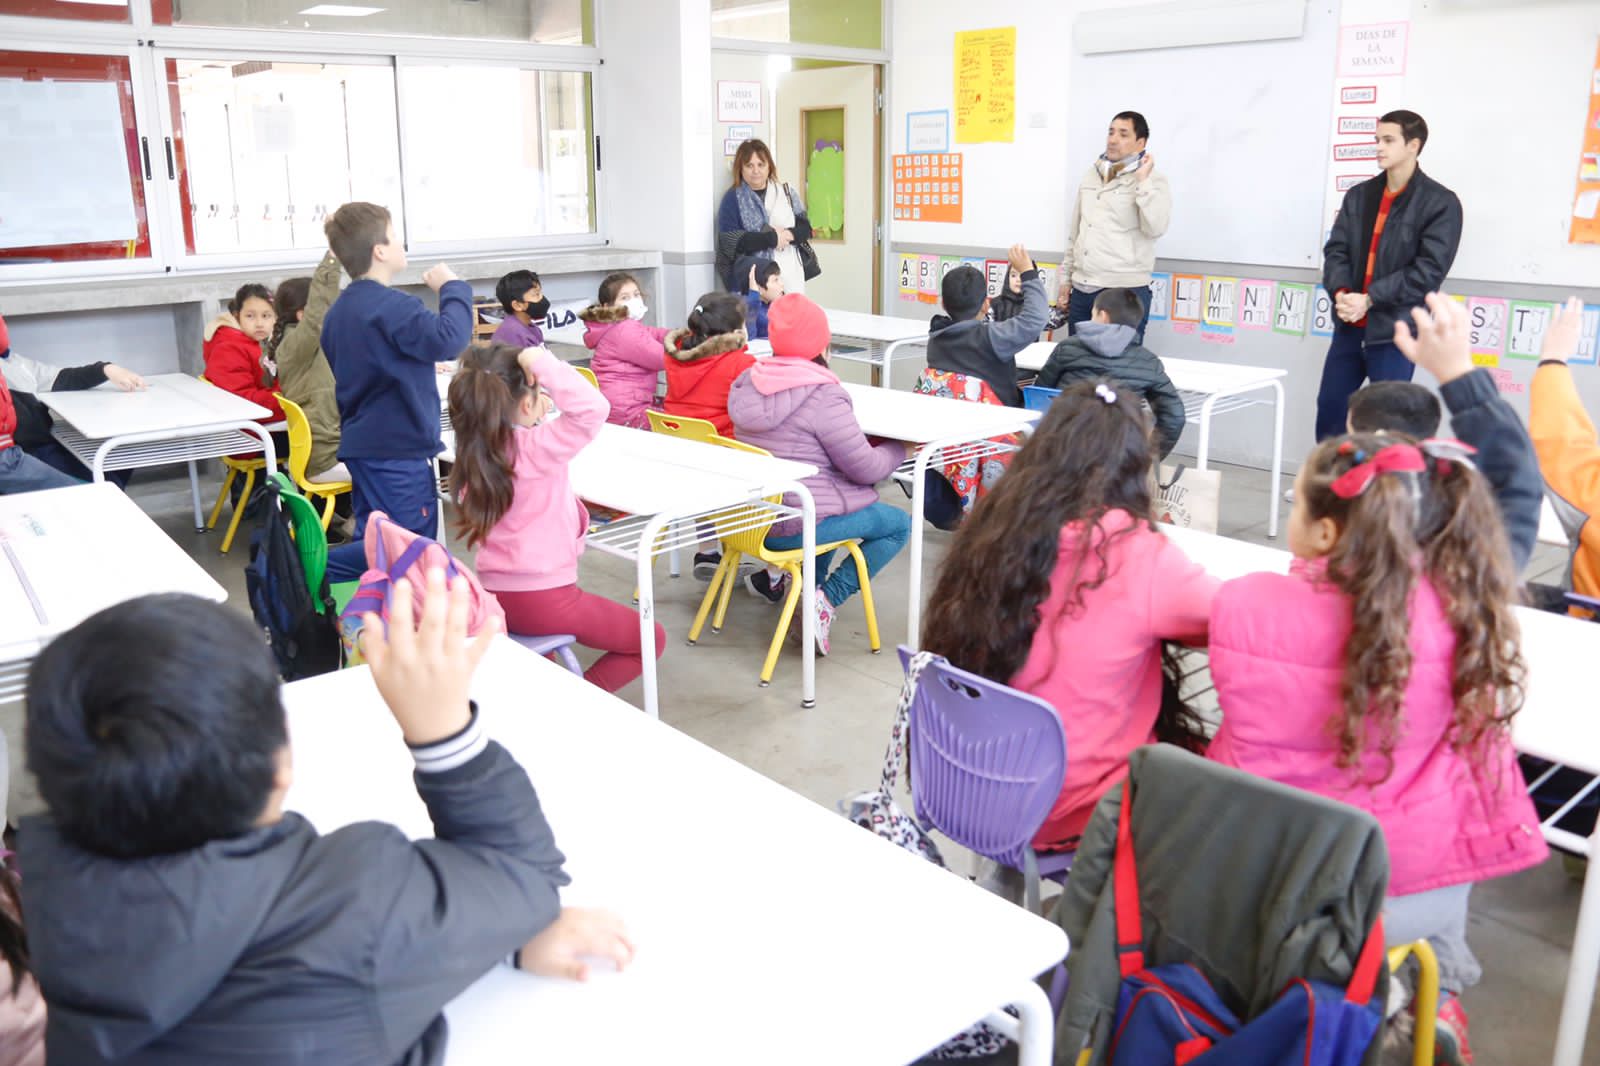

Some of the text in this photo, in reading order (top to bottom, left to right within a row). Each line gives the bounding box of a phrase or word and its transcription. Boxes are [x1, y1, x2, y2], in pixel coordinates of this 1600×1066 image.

[1382, 29, 1397, 39] DE
[1367, 42, 1382, 53] LA
[1352, 55, 1395, 66] SEMANA
[1344, 91, 1372, 100] Lunes
[1343, 120, 1375, 130] Martes
[901, 259, 909, 275] A
[920, 261, 929, 276] B
[988, 265, 997, 283] E
[902, 277, 909, 287] a
[1038, 269, 1046, 284] G
[988, 285, 996, 295] e
[1176, 280, 1187, 300] L
[1208, 283, 1222, 304] M
[1244, 287, 1258, 307] N
[1207, 305, 1220, 319] m
[1316, 297, 1330, 313] O
[536, 309, 577, 330] ILA
[1243, 310, 1253, 322] n
[1314, 316, 1326, 328] o
[1471, 306, 1486, 328] S
[1515, 309, 1531, 333] T
[1470, 331, 1480, 345] s
[1511, 336, 1517, 350] t
